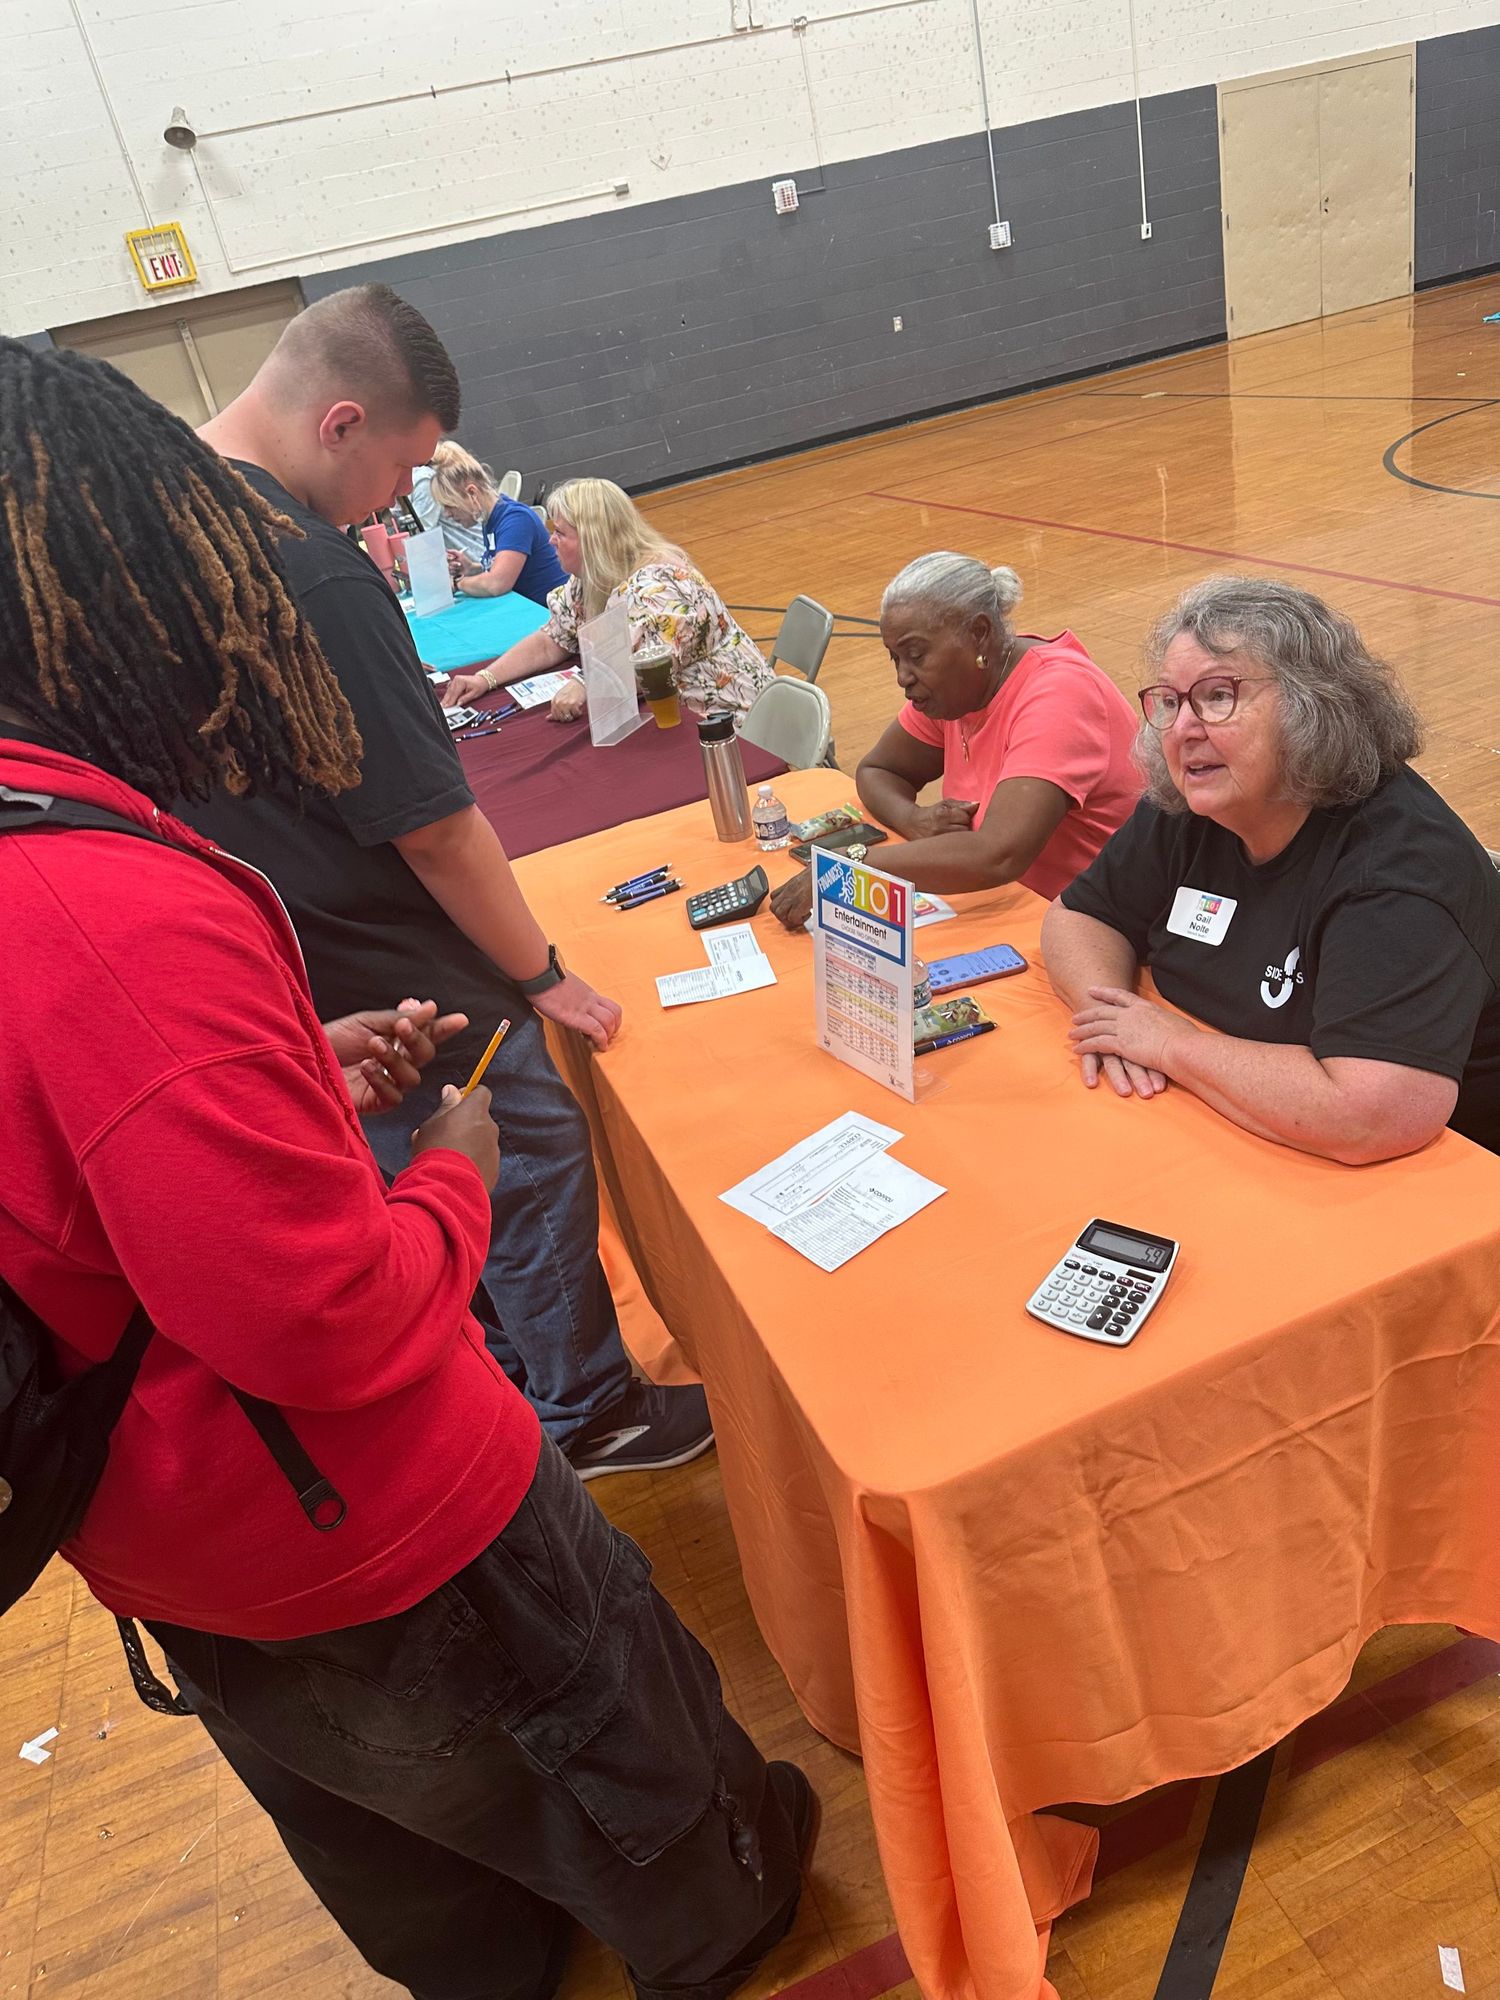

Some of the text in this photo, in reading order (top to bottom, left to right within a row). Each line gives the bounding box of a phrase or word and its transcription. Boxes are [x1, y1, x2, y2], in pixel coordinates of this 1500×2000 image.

[149, 253, 181, 281] EXIT
[818, 862, 845, 894] FINANCES
[858, 875, 901, 923] 101
[834, 907, 887, 941] Entertainment
[1189, 921, 1210, 934] Nolte
[1195, 913, 1212, 925] Gail
